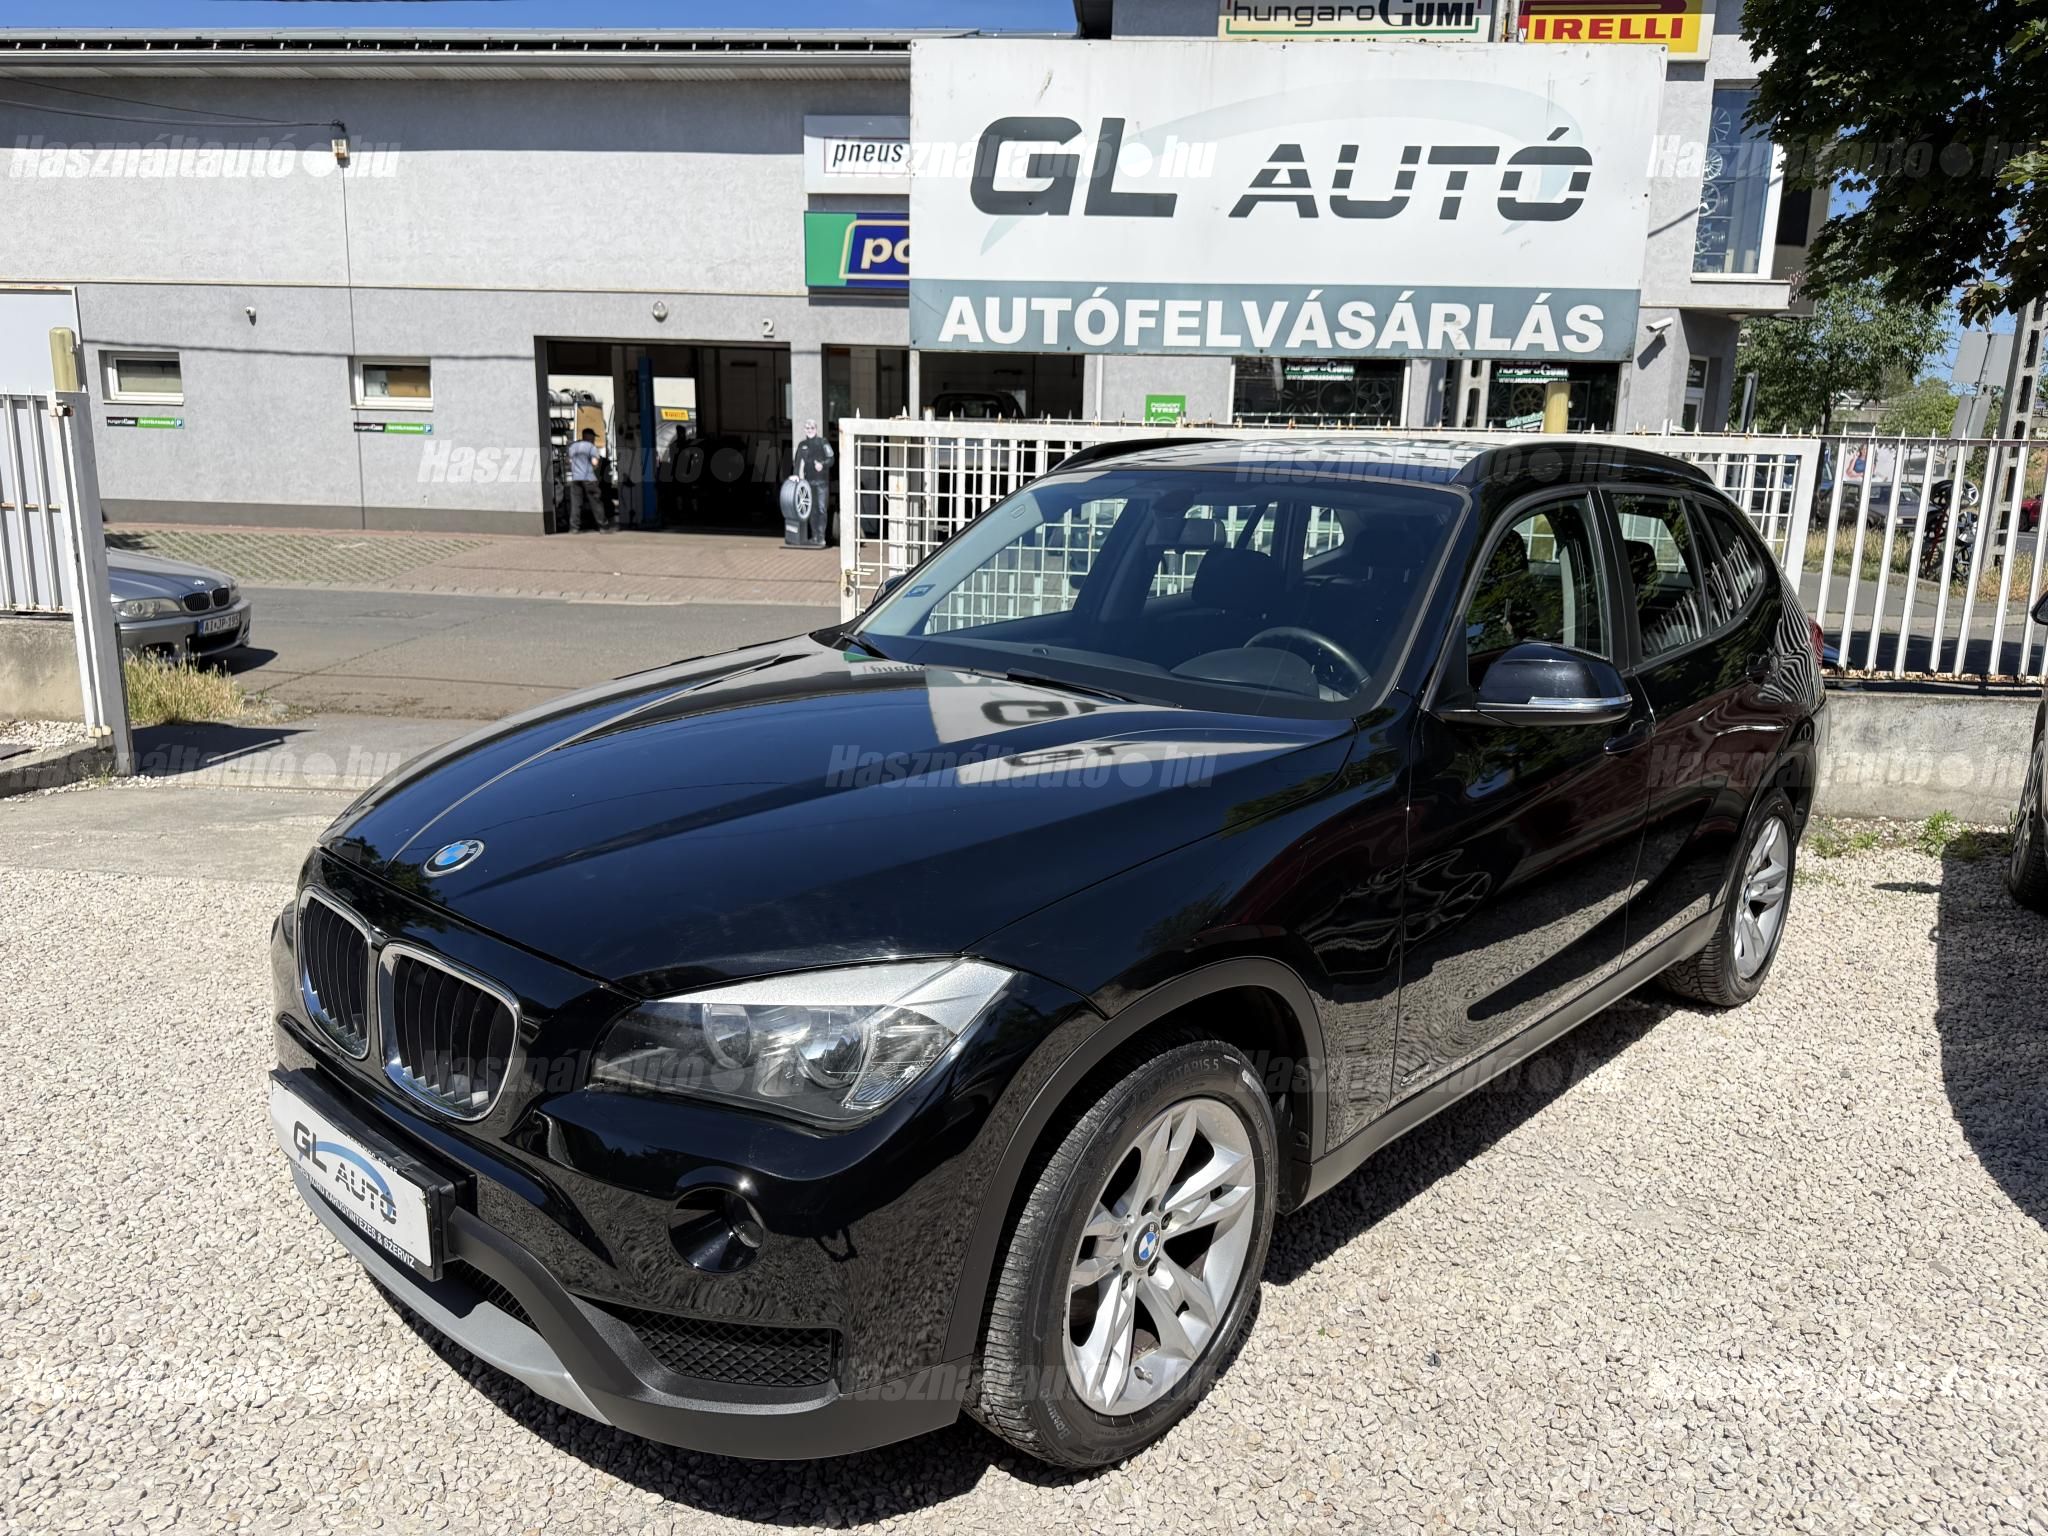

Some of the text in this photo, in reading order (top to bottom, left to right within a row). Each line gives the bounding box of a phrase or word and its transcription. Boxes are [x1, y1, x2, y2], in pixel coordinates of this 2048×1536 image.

[833, 142, 904, 167] pneus
[970, 116, 1593, 222] GL AUTÓ
[762, 318, 775, 337] 2
[938, 287, 1604, 353] AUTÓFELVÁSÁRLÁS
[293, 1120, 327, 1173] GL
[383, 1237, 415, 1268] SZERVIZ
